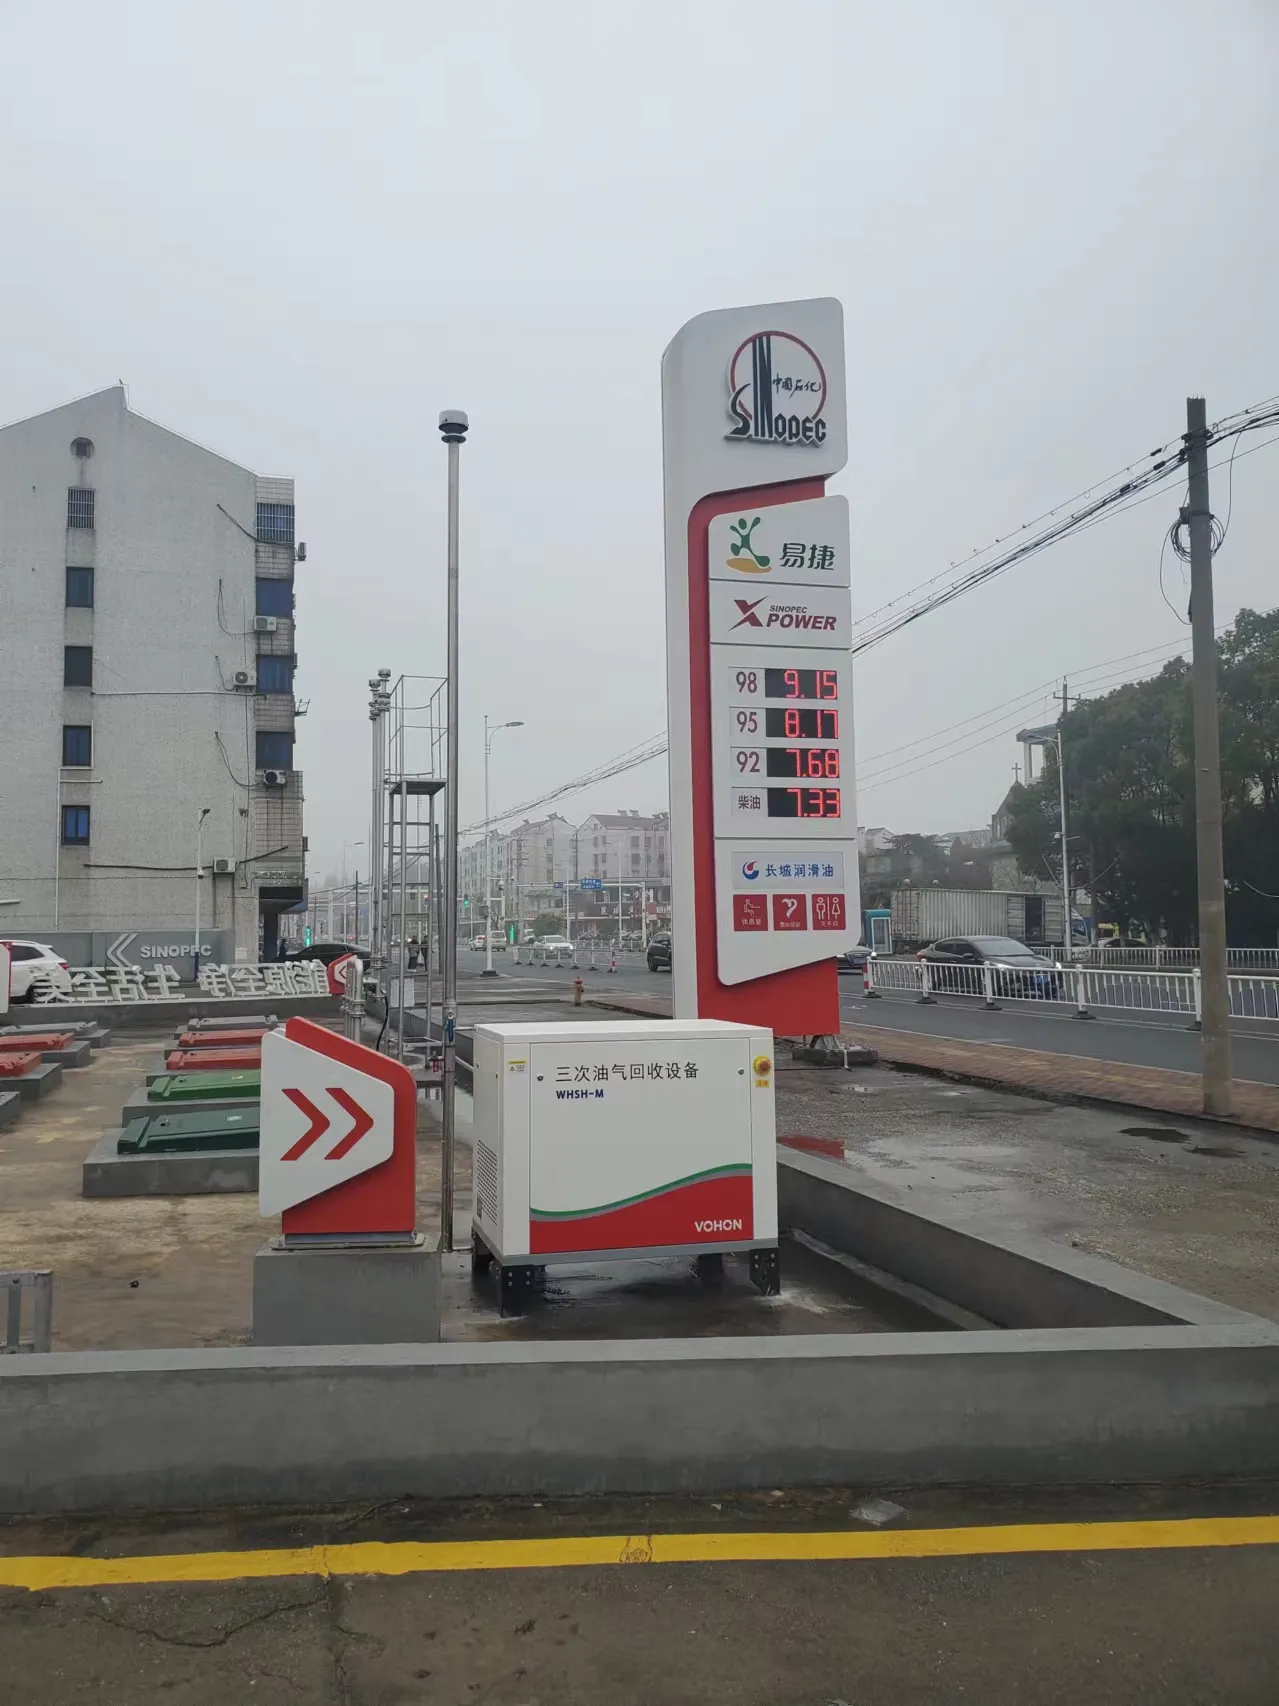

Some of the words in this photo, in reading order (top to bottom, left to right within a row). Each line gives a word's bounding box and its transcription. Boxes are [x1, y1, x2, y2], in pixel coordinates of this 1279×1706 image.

[779, 543, 835, 571] 易捷
[769, 605, 808, 614] SINOPEC
[767, 614, 837, 631] POWER
[735, 671, 758, 694] 98
[784, 670, 838, 700] 9.15
[736, 711, 758, 733] 95
[785, 709, 839, 739] 8.17
[736, 751, 760, 773] 92
[785, 749, 839, 778] 7.68
[738, 795, 761, 810] 柴油
[787, 788, 840, 817] 7.33
[765, 863, 834, 878] 长城润滑油
[555, 1062, 700, 1083] 三次油气回收设备
[556, 1088, 604, 1100] WHSH-M
[694, 1219, 742, 1232] VOHON
